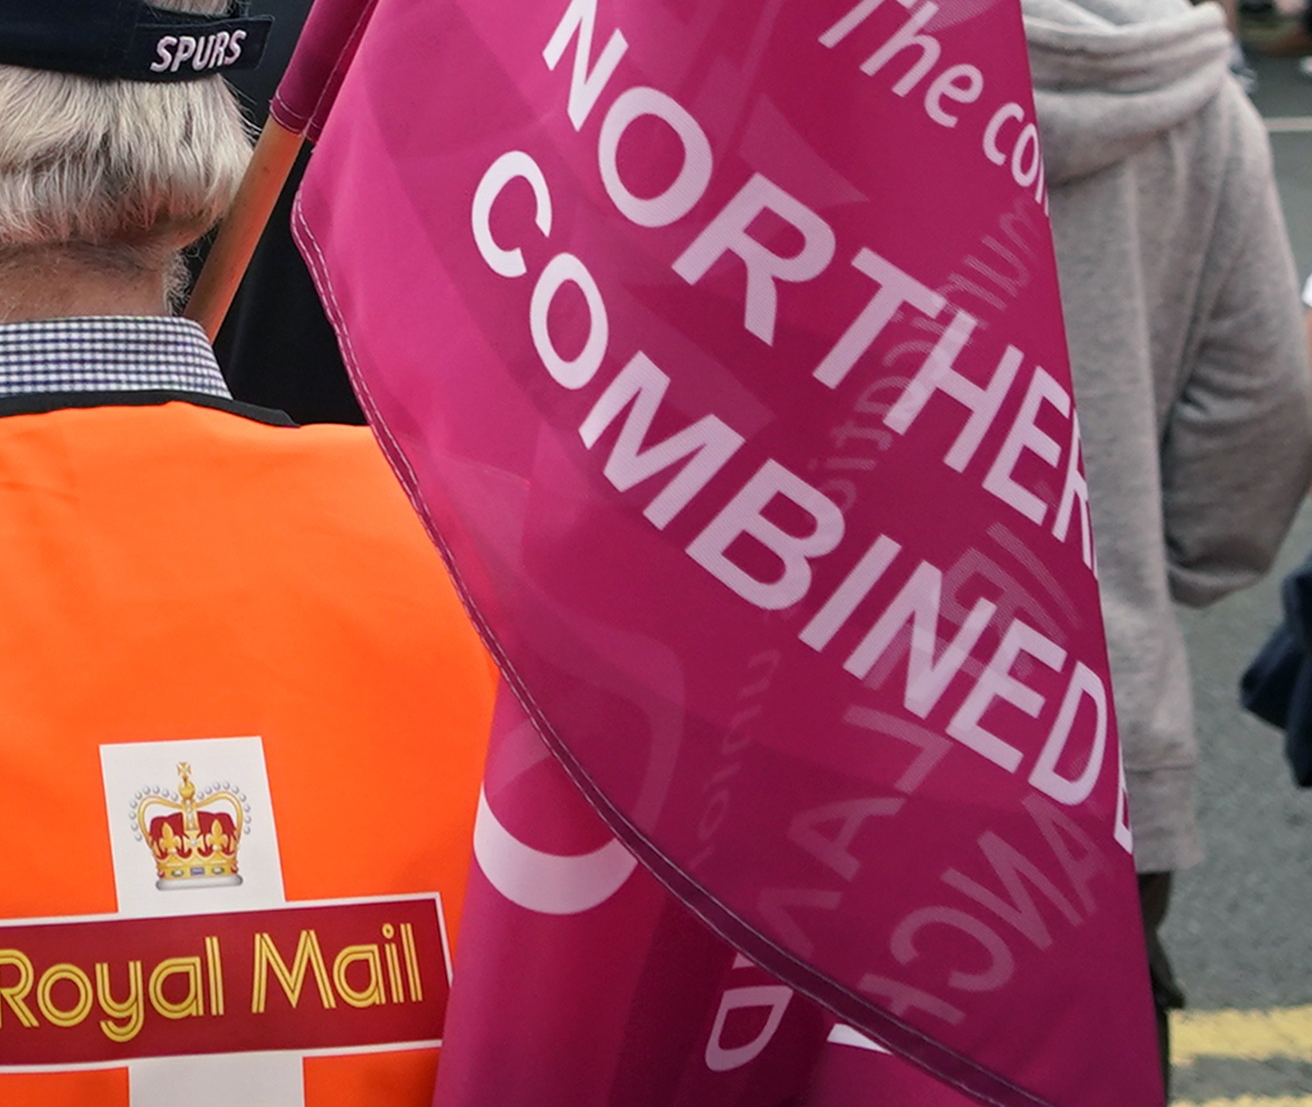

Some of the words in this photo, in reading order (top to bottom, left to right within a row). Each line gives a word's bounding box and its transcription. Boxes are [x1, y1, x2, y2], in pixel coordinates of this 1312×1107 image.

[150, 29, 247, 73] SPURS
[471, 151, 1107, 806] COMBINED
[251, 922, 424, 1014] Mail
